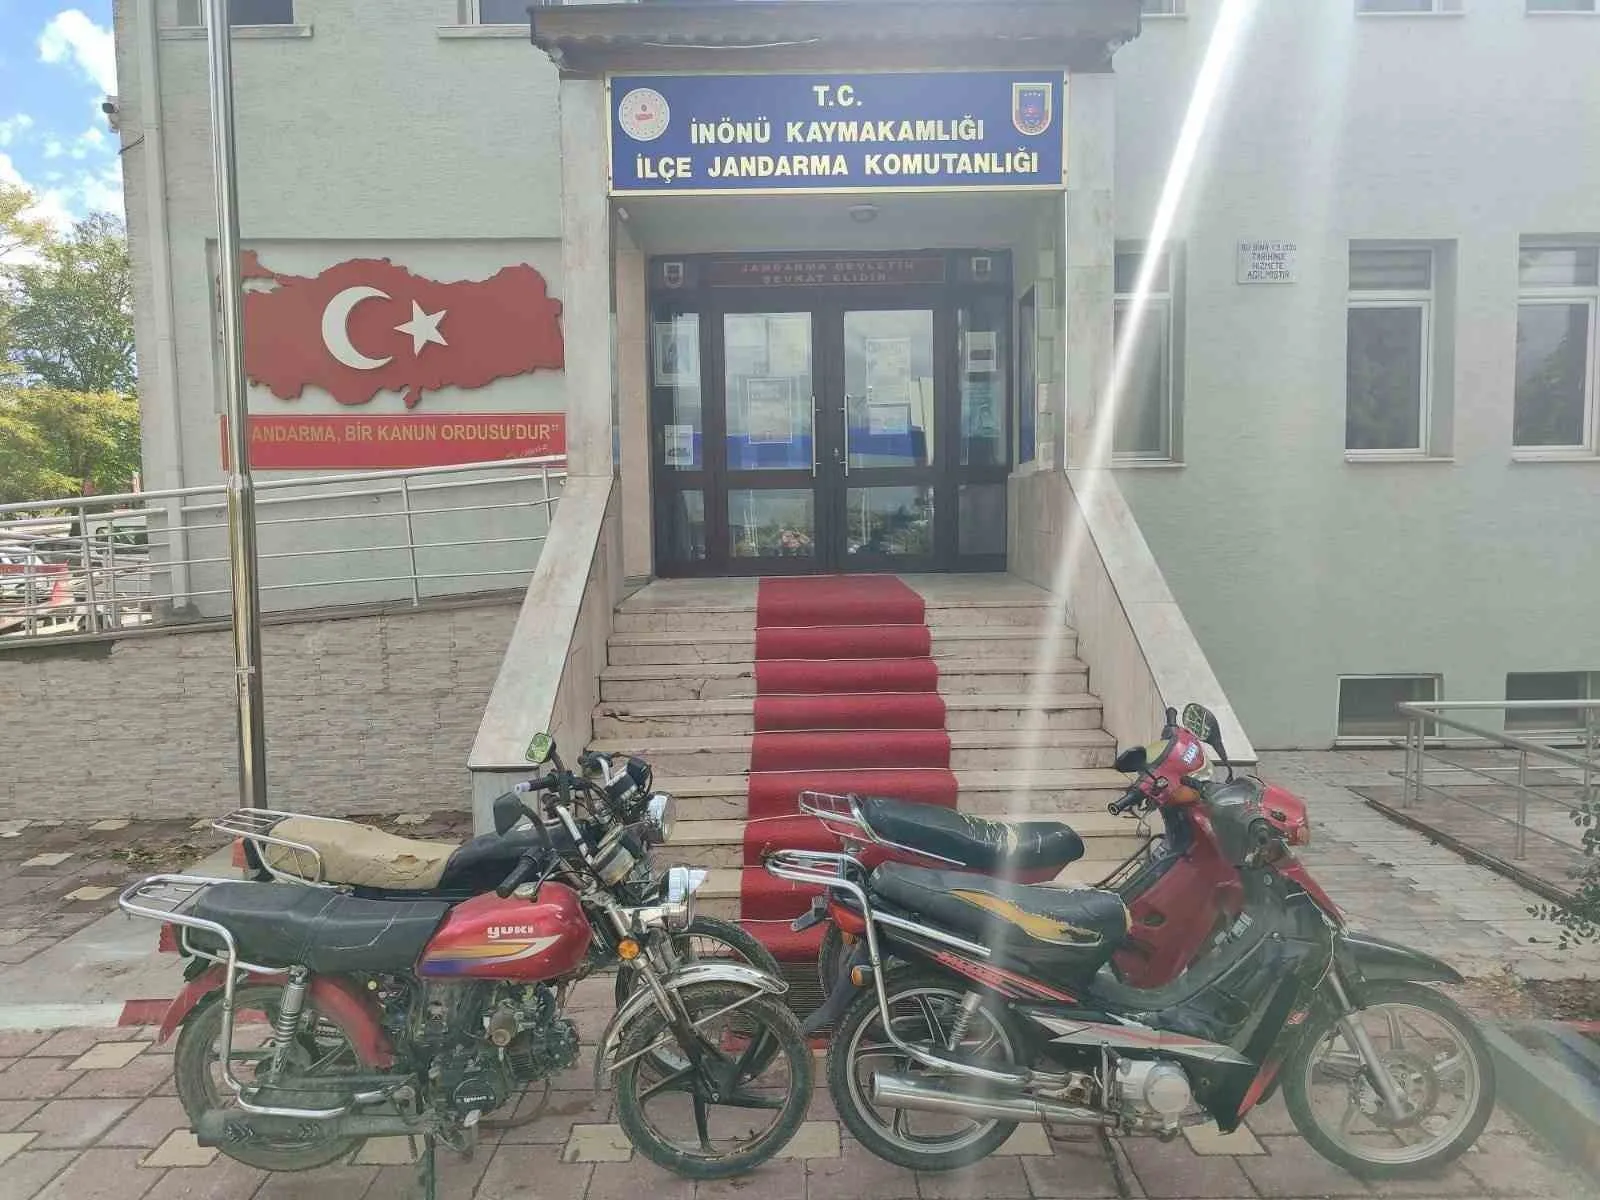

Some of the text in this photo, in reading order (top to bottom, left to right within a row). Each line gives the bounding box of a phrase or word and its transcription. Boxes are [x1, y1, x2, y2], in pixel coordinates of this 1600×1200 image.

[812, 85, 863, 107] T.C.
[690, 117, 771, 144] İNÖNÜ
[787, 114, 984, 143] KAYMAKAMLIĞI
[636, 146, 1039, 183] İLÇE JANDARMA KOMUTANLIĞI
[250, 424, 341, 444] ANDARMA,
[344, 421, 373, 442] BİR
[378, 423, 437, 441] KANUN
